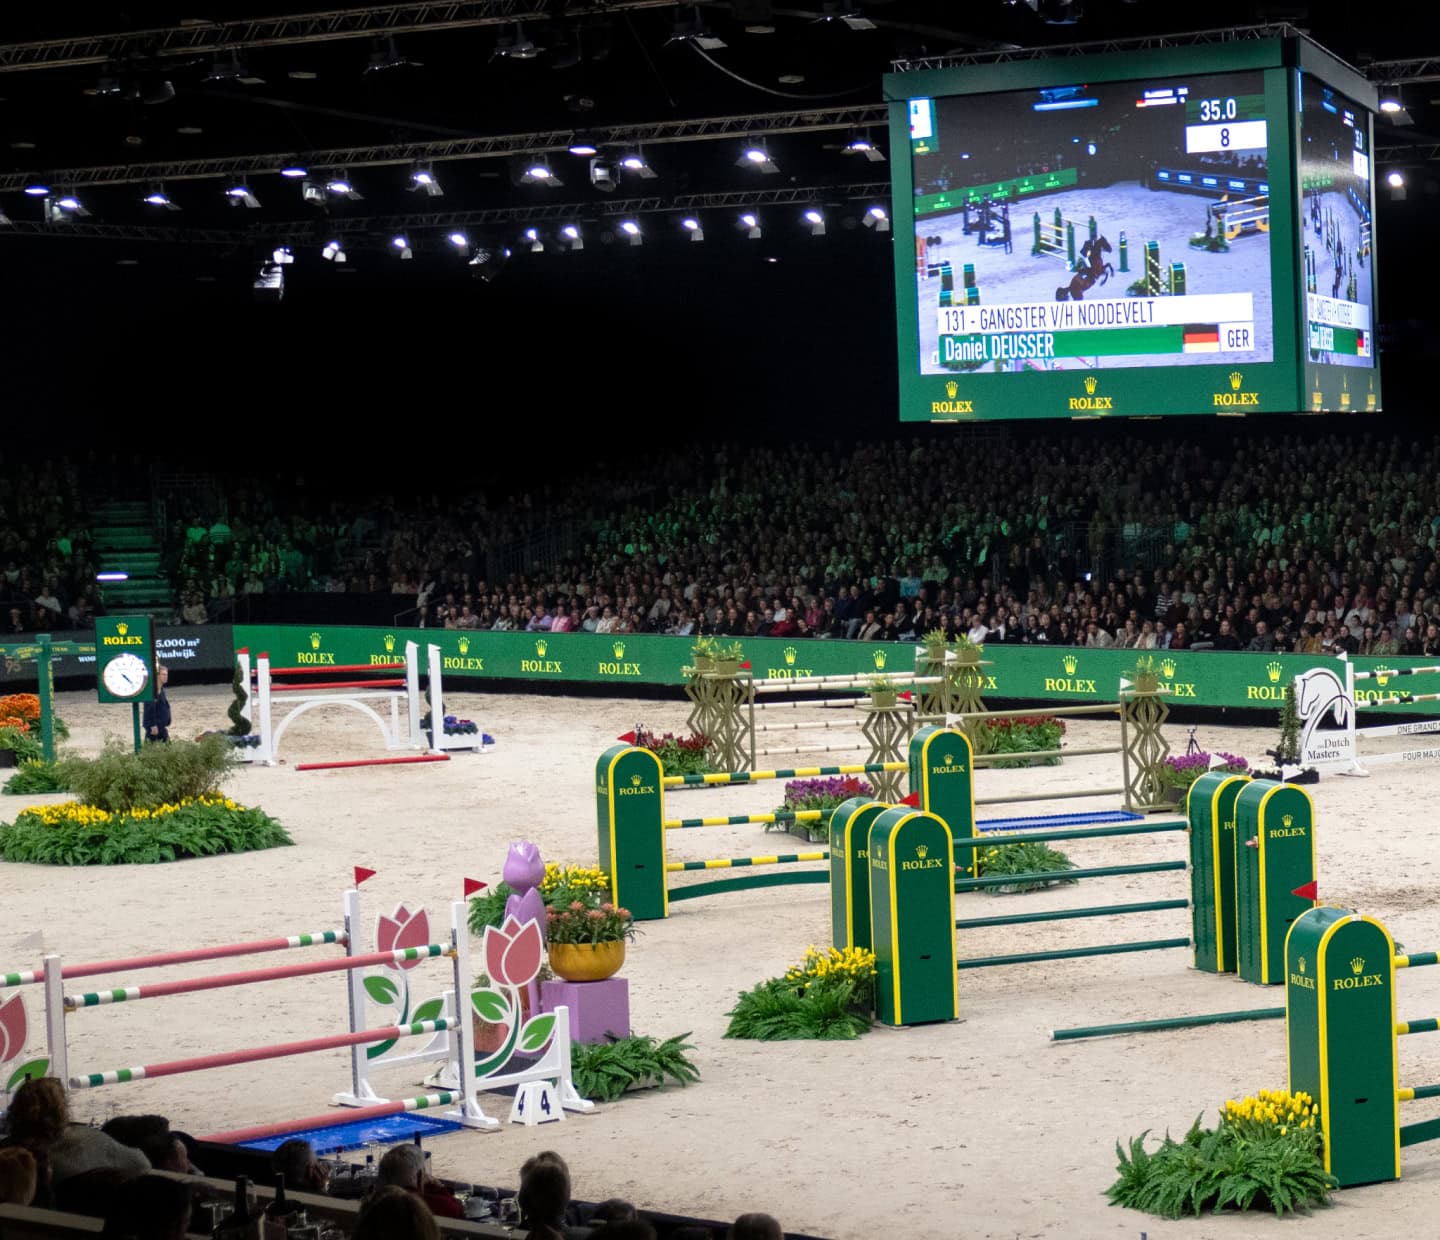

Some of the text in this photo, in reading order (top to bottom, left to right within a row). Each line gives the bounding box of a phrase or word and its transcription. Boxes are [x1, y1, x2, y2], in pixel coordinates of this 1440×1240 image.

[1200, 98, 1236, 121] 35.0
[1220, 128, 1230, 147] 8
[945, 309, 966, 332] 131
[980, 306, 1047, 330] GANGSTER
[1050, 303, 1074, 328] V/H
[1078, 301, 1155, 326] NODDEVELT
[1227, 328, 1250, 348] GER
[945, 333, 1055, 361] Daniel DEUSSER
[1069, 397, 1113, 410] ROLEX
[1213, 393, 1259, 406] ROLEX
[932, 401, 973, 414] ROLEX
[103, 636, 143, 646] ROLEX
[297, 652, 335, 665] ROLEX
[444, 657, 483, 670] ROLEX
[521, 660, 562, 673] ROLEX
[599, 663, 641, 675] ROLEX
[1045, 678, 1096, 693] ROLEX
[1247, 685, 1288, 700] ROLE
[1397, 725, 1412, 734] ONE
[1413, 722, 1438, 732] GRAND
[1324, 736, 1350, 749] Dutch
[1307, 750, 1340, 760] Masters
[1402, 751, 1422, 761] FOUR
[933, 765, 965, 775] ROLEX
[619, 785, 655, 796] ROLEX
[1270, 827, 1306, 839] ROLEX
[902, 859, 943, 871] ROLEX
[1290, 973, 1315, 990] ROLEX
[1333, 974, 1383, 991] ROLEX
[517, 1090, 526, 1116] 4
[540, 1089, 550, 1115] 4
